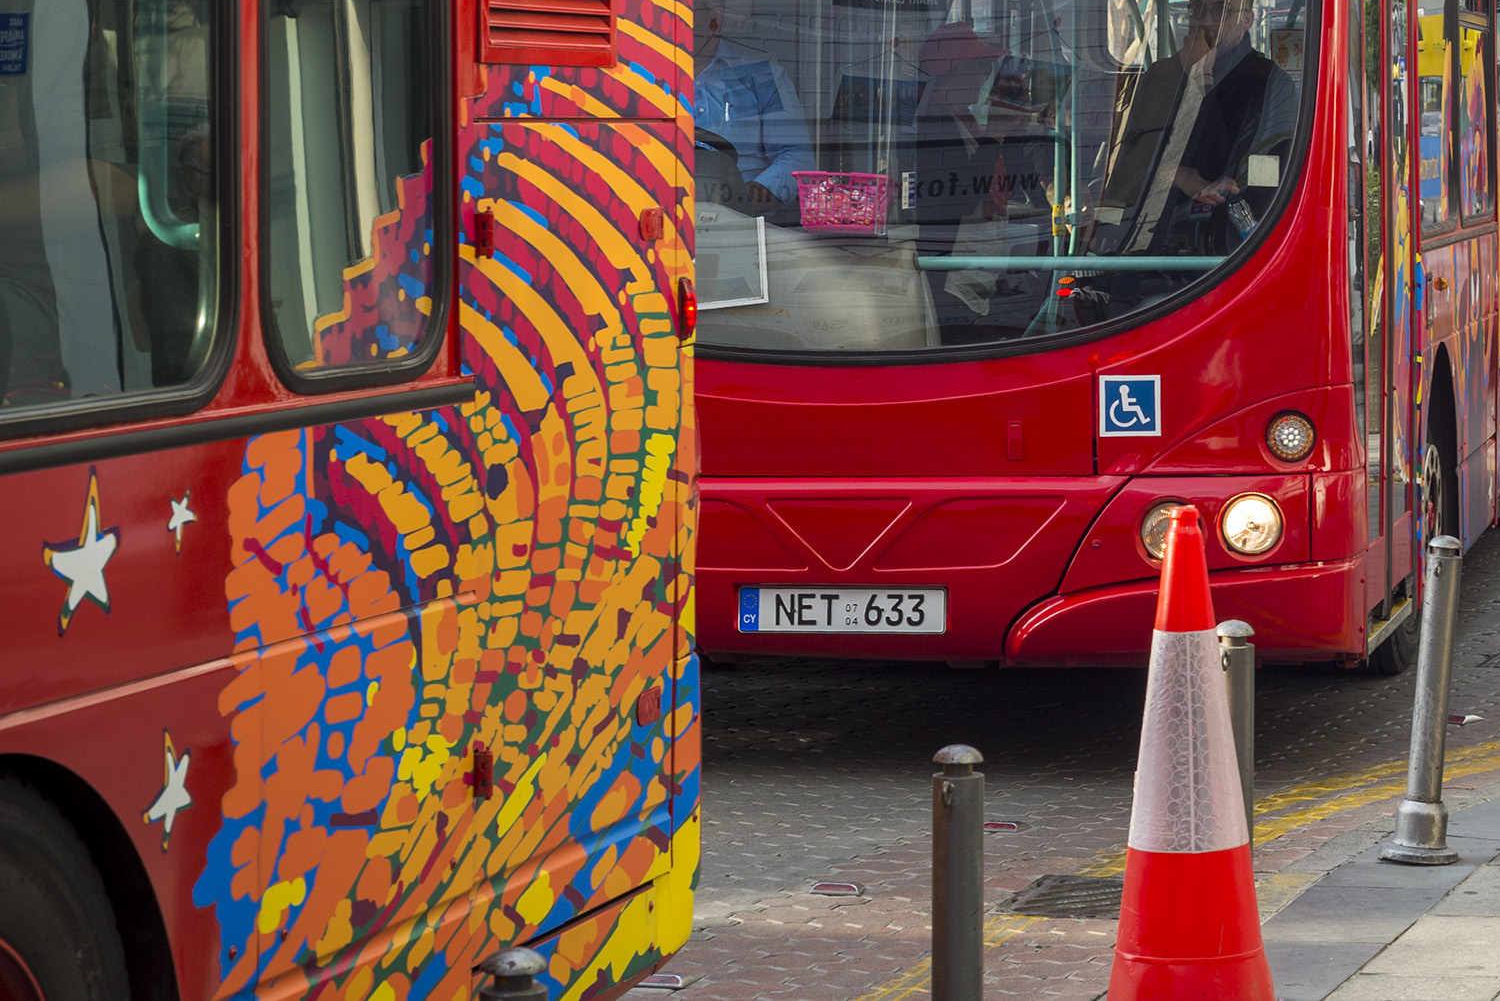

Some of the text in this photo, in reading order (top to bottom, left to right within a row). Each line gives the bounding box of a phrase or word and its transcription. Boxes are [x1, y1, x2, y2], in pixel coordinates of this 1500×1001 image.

[774, 593, 925, 626] NET 633
[845, 603, 858, 613] 07
[743, 614, 757, 624] CY
[845, 617, 858, 626] 04
